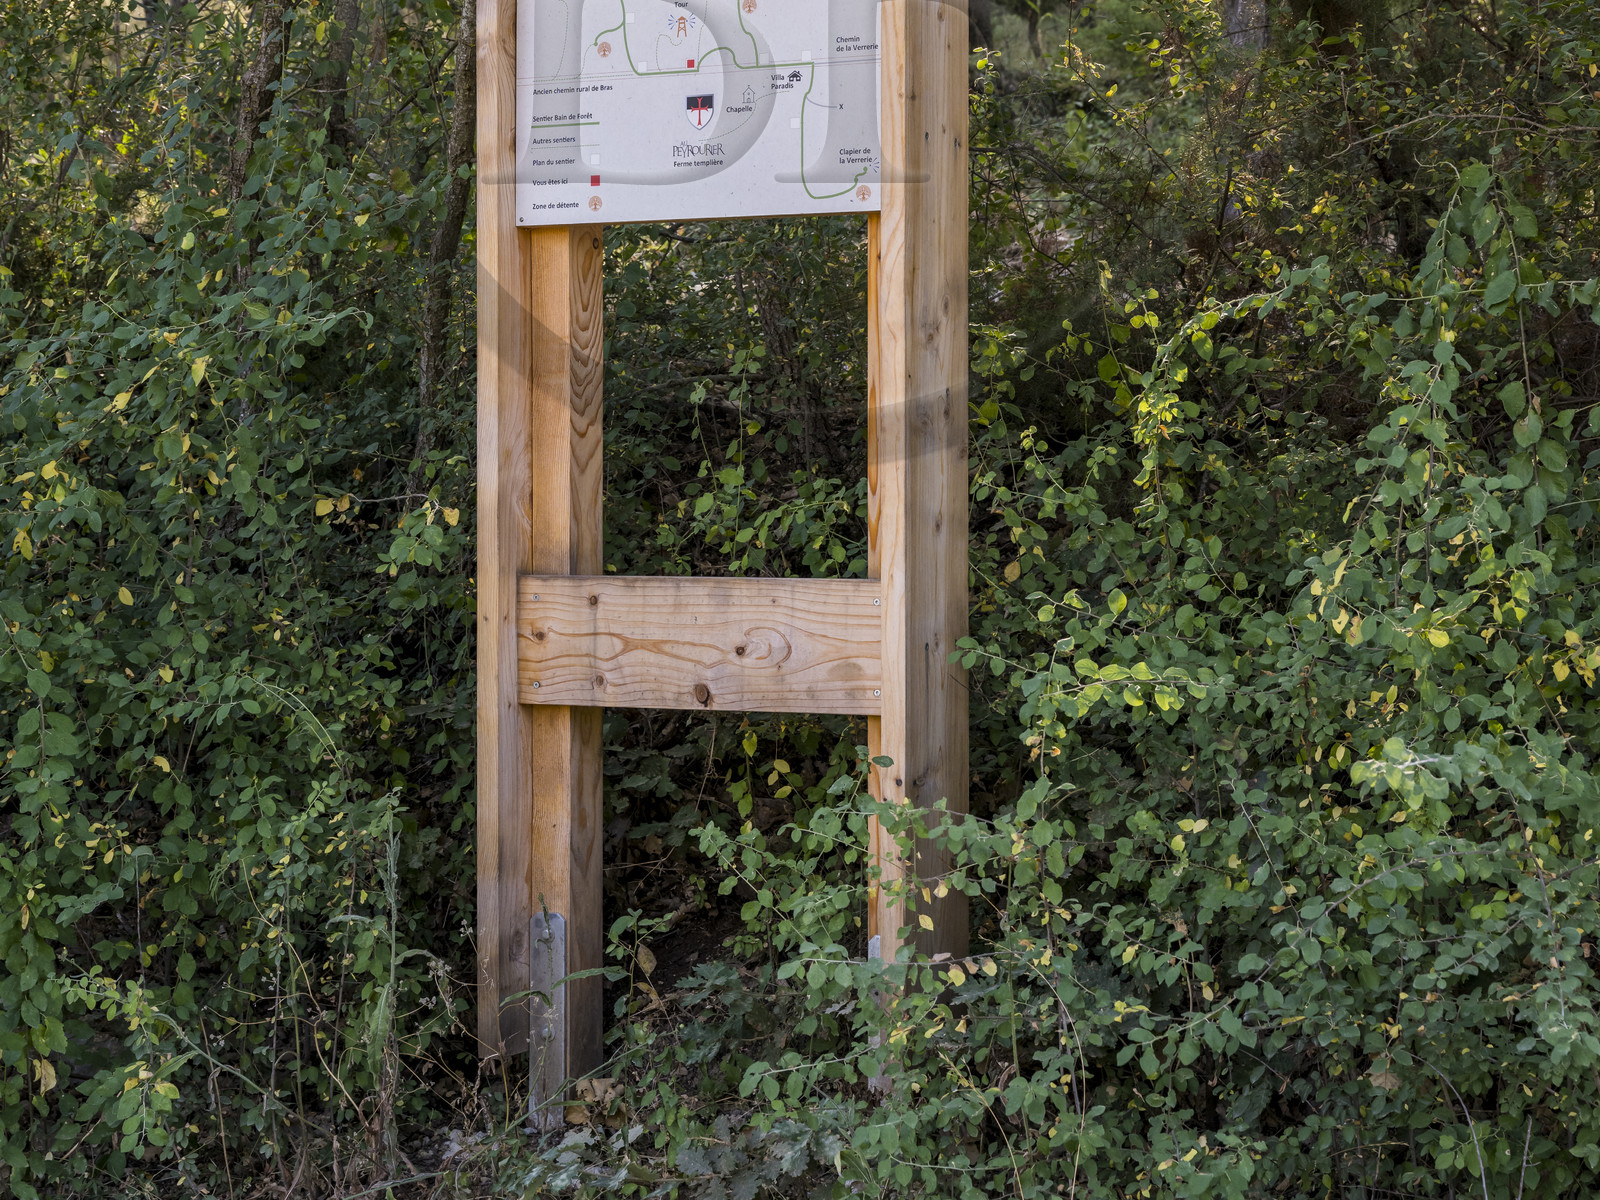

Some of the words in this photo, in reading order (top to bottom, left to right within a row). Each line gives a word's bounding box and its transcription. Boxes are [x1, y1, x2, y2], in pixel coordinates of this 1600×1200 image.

[836, 36, 860, 44] Chemin
[852, 43, 879, 51] Verrerie
[771, 73, 784, 81] Villa
[533, 88, 553, 96] Ancien
[553, 86, 575, 94] chemin
[576, 85, 590, 93] rural
[591, 84, 599, 92] de
[771, 82, 794, 90] Paradis
[726, 105, 752, 114] Chapelle
[532, 115, 553, 123] Sentier
[577, 112, 593, 120] Forêt
[532, 137, 552, 145] Autres
[672, 142, 725, 157] PEYROURIER
[839, 148, 861, 157] Clapier
[546, 158, 554, 166] du
[555, 157, 575, 165] sentier
[673, 160, 693, 168] Ferme
[694, 159, 724, 168] templière
[556, 201, 579, 209] détente
